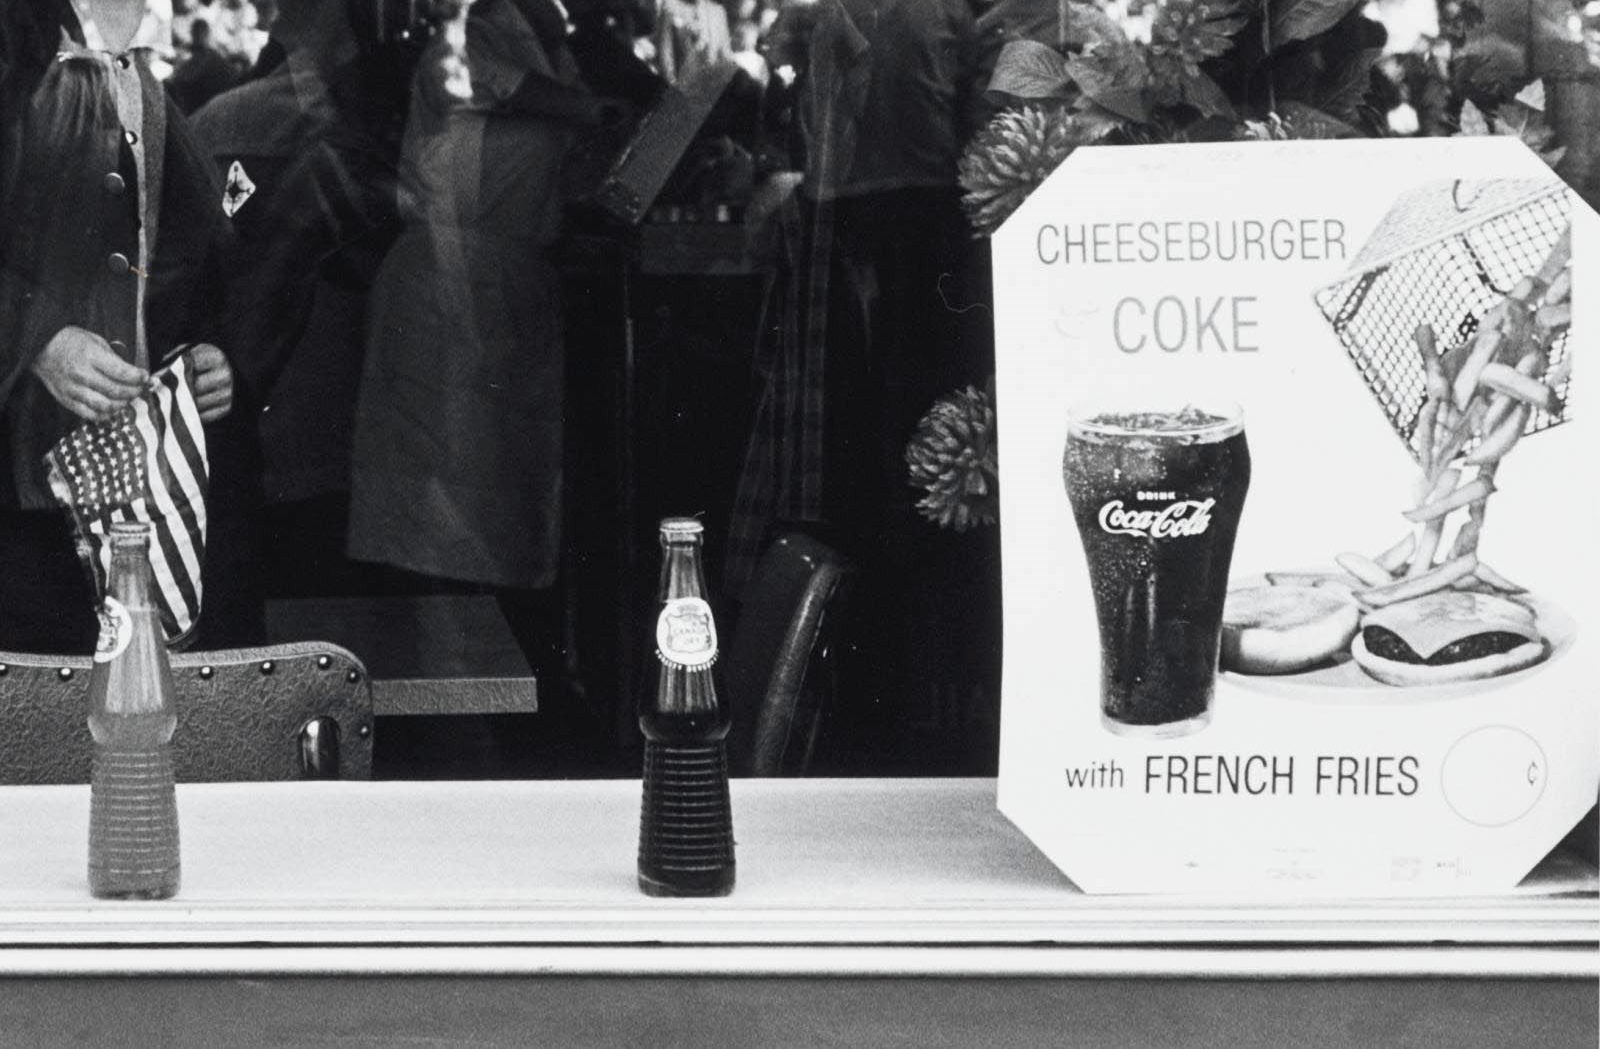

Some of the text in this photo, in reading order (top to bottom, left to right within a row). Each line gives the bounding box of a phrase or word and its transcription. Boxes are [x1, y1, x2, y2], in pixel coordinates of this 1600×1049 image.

[1036, 218, 1348, 265] CHEESEBURGER
[1112, 295, 1261, 355] COKE
[1098, 497, 1217, 538] Coca-Cola
[1065, 759, 1125, 789] with
[1144, 755, 1295, 795] FRENCH
[1314, 755, 1421, 796] FRIES
